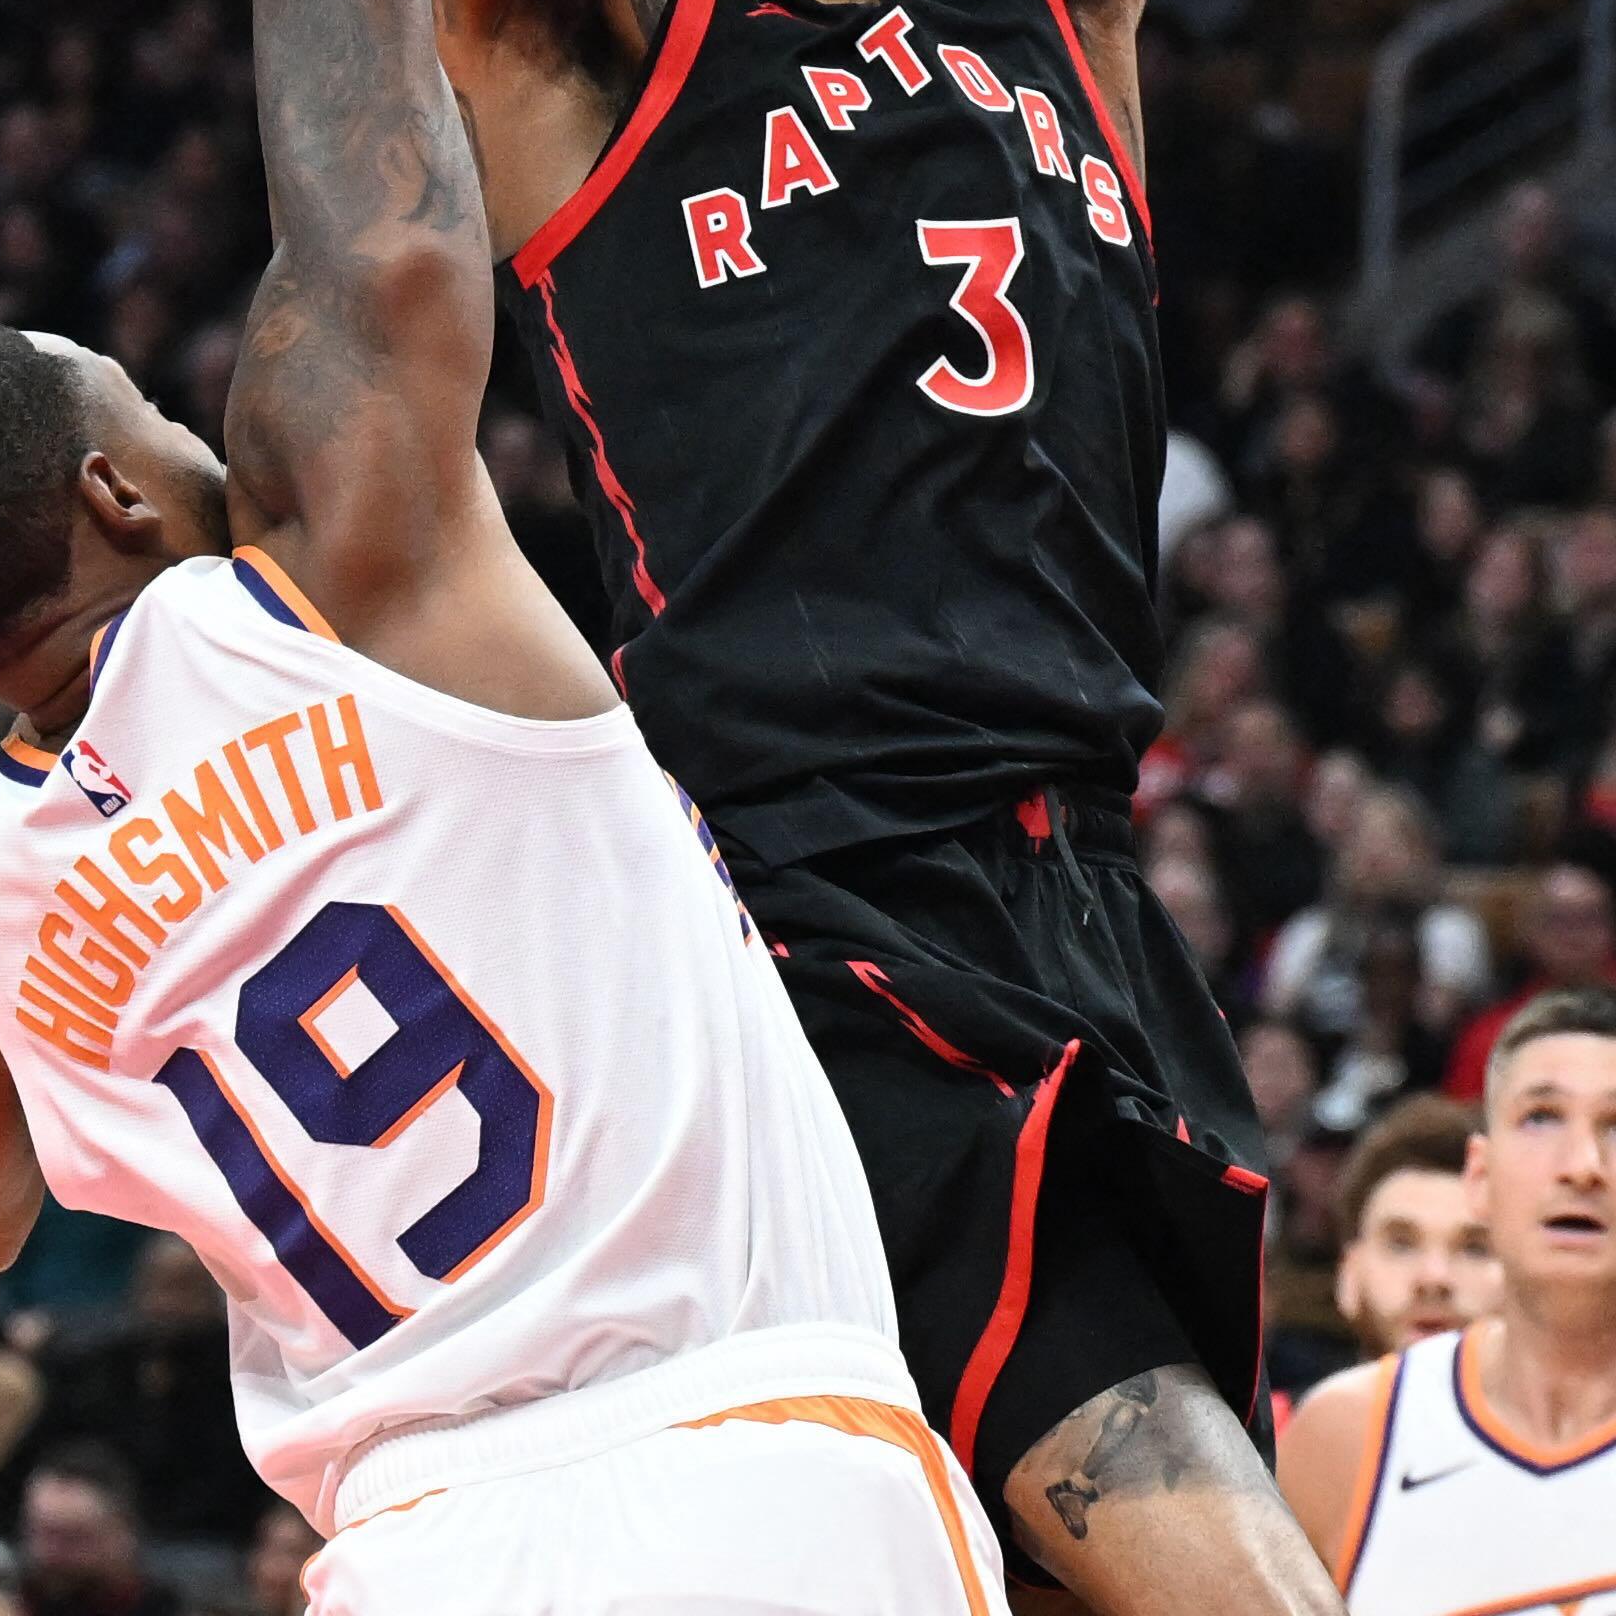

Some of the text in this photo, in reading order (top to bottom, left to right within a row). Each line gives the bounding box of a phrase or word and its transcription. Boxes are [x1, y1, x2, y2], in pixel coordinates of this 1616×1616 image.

[681, 5, 1132, 289] RAPTORS
[915, 217, 1035, 417] 3
[15, 693, 384, 1072] HIGHSMITH
[151, 900, 554, 1352] 19
